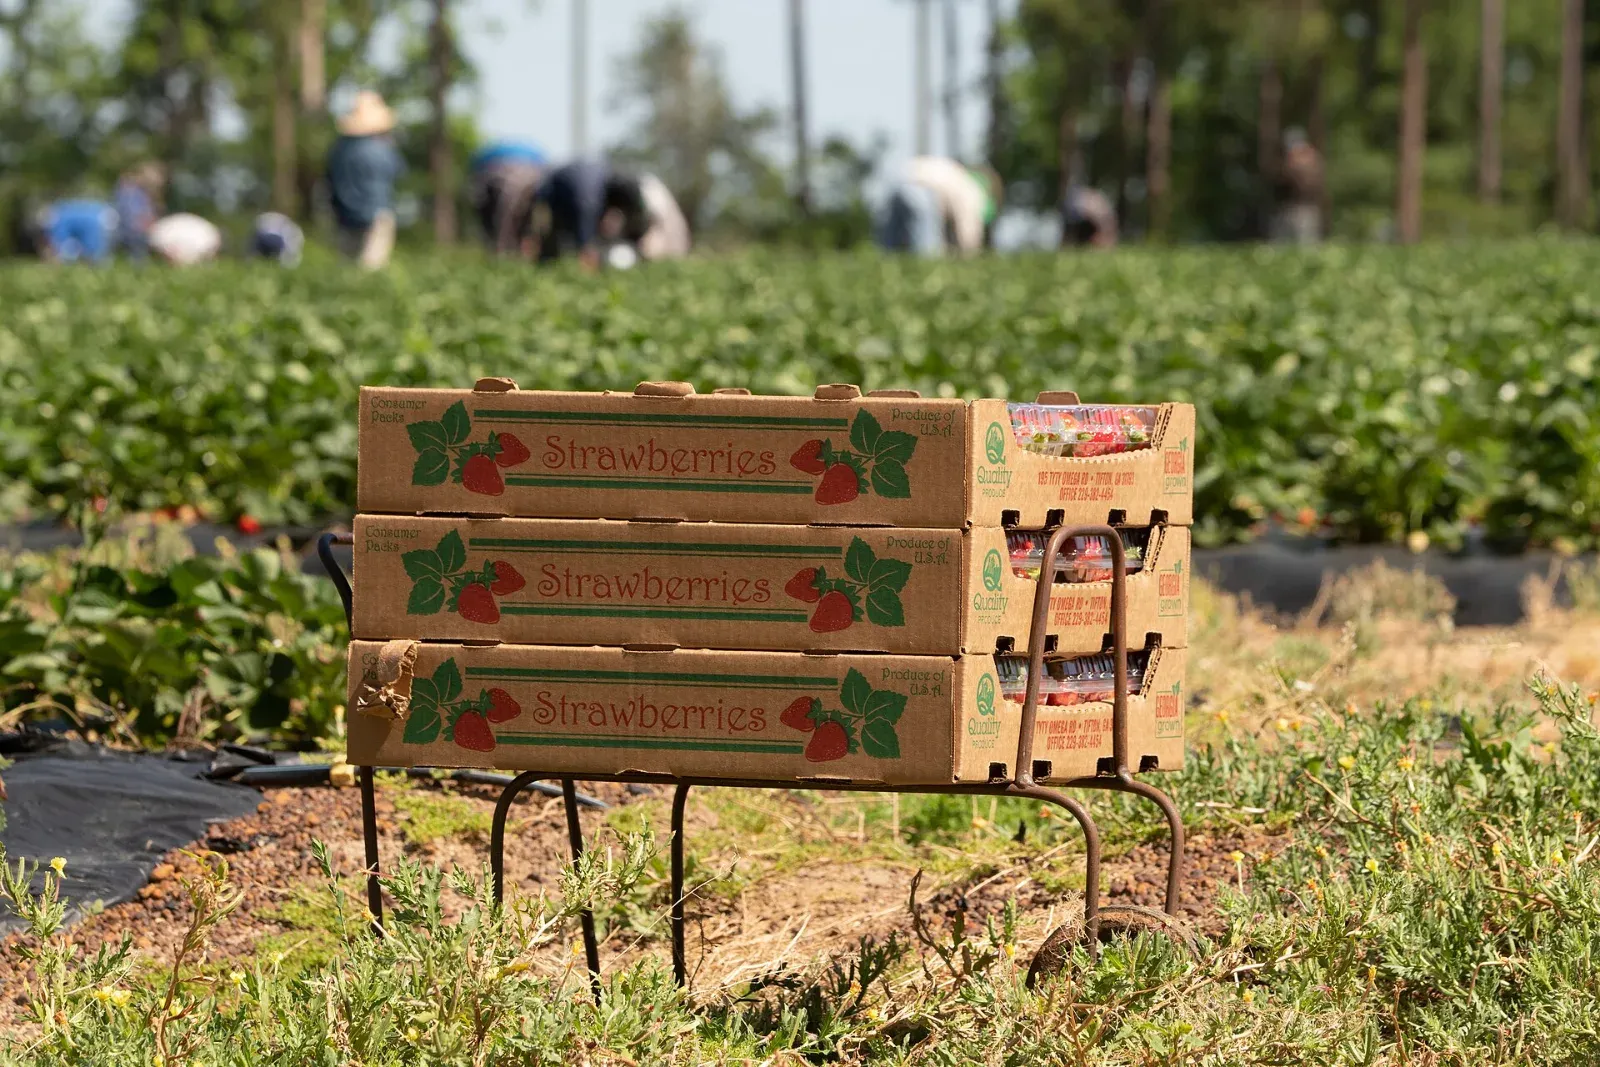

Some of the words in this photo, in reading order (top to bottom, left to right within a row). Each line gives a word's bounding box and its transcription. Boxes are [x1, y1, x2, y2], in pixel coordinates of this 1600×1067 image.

[371, 396, 427, 409] Consumer
[371, 410, 405, 424] Packs
[891, 408, 941, 422] Produce
[943, 410, 956, 425] of
[920, 423, 955, 438] U.S.A.
[541, 435, 777, 478] Strawberries
[1164, 451, 1186, 474] GEORGIA
[976, 465, 1013, 488] Quality
[1049, 471, 1062, 486] TYTY
[1062, 471, 1081, 486] OMEGA
[1081, 471, 1089, 486] RD
[1165, 476, 1187, 490] grown
[1059, 487, 1078, 501] OFFICE
[365, 525, 422, 539] Consumer
[365, 540, 400, 553] Packs
[886, 536, 935, 550] Produce
[937, 537, 950, 553] of
[914, 551, 949, 566] U.S.A.
[537, 563, 771, 606] Strawberries
[1159, 573, 1180, 597] GEORGIA
[973, 592, 1009, 614] Quality
[1056, 596, 1075, 611] OMEGA
[1075, 596, 1085, 611] RD
[1160, 598, 1182, 612] grown
[1053, 612, 1073, 627] OFFICE
[881, 667, 931, 681] Produce
[933, 669, 945, 684] of
[909, 683, 944, 698] U.S.A.
[532, 690, 768, 735] Strawberries
[1156, 694, 1178, 718] GEORGIA
[967, 717, 1002, 739] Quality
[1036, 720, 1049, 735] TYTY
[1048, 719, 1068, 735] OMEGA
[1068, 719, 1078, 734] RD
[1157, 720, 1180, 735] grown
[1046, 735, 1066, 751] OFFICE
